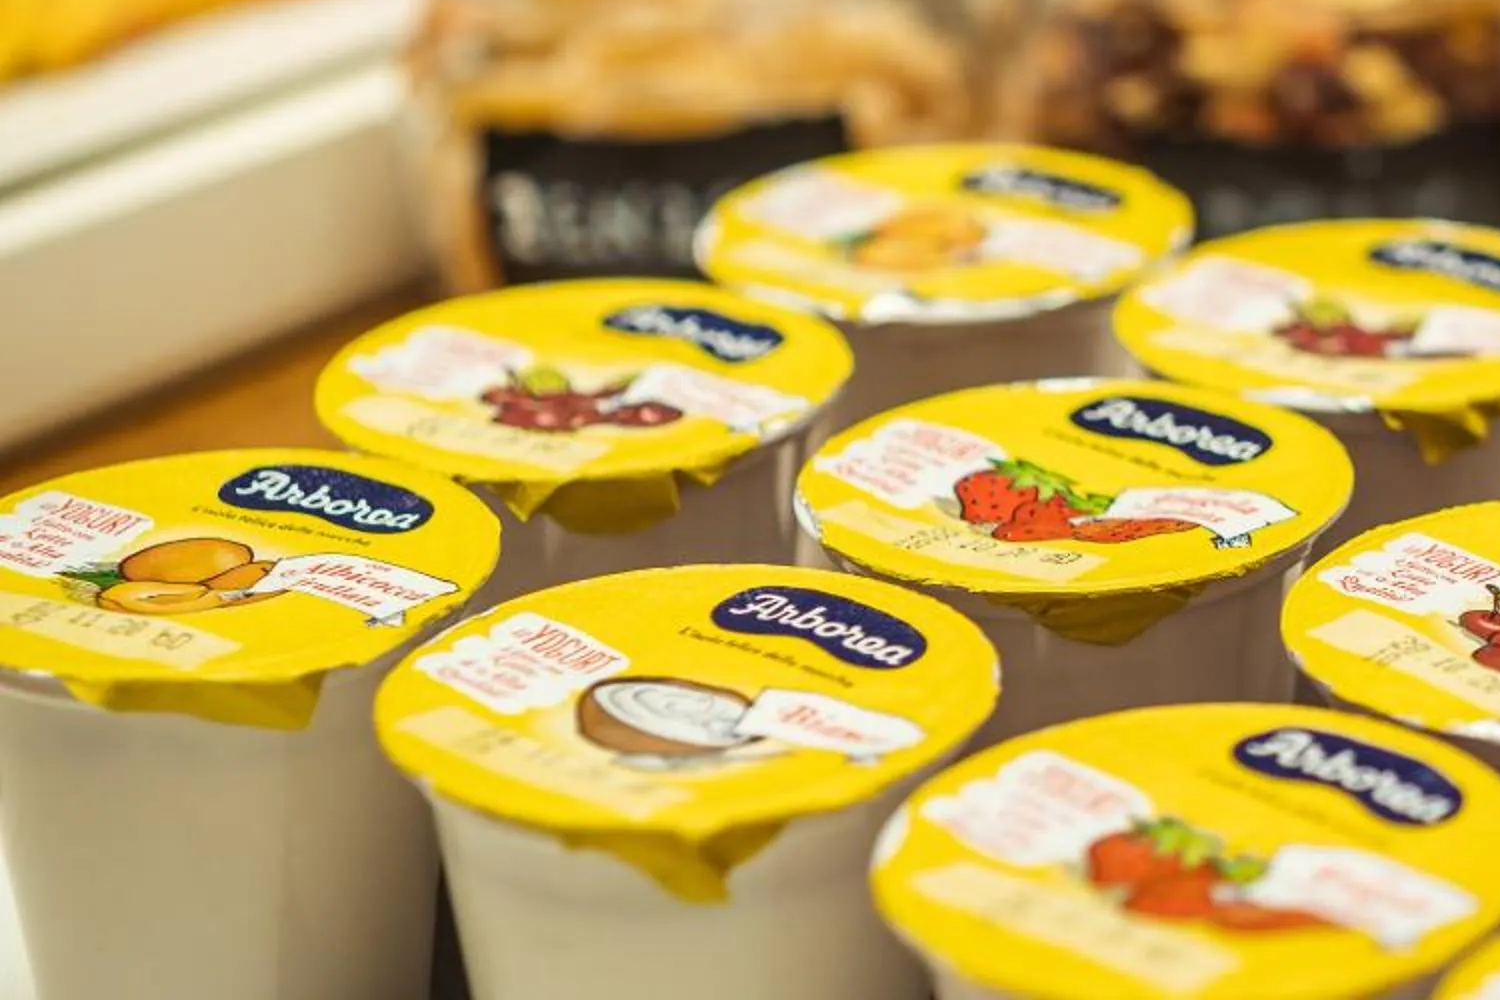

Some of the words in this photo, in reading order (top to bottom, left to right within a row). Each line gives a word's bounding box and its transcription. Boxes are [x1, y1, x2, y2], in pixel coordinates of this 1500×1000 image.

[1082, 399, 1262, 461] Arborea
[235, 469, 420, 528] Arborea
[728, 593, 913, 665] Arborea
